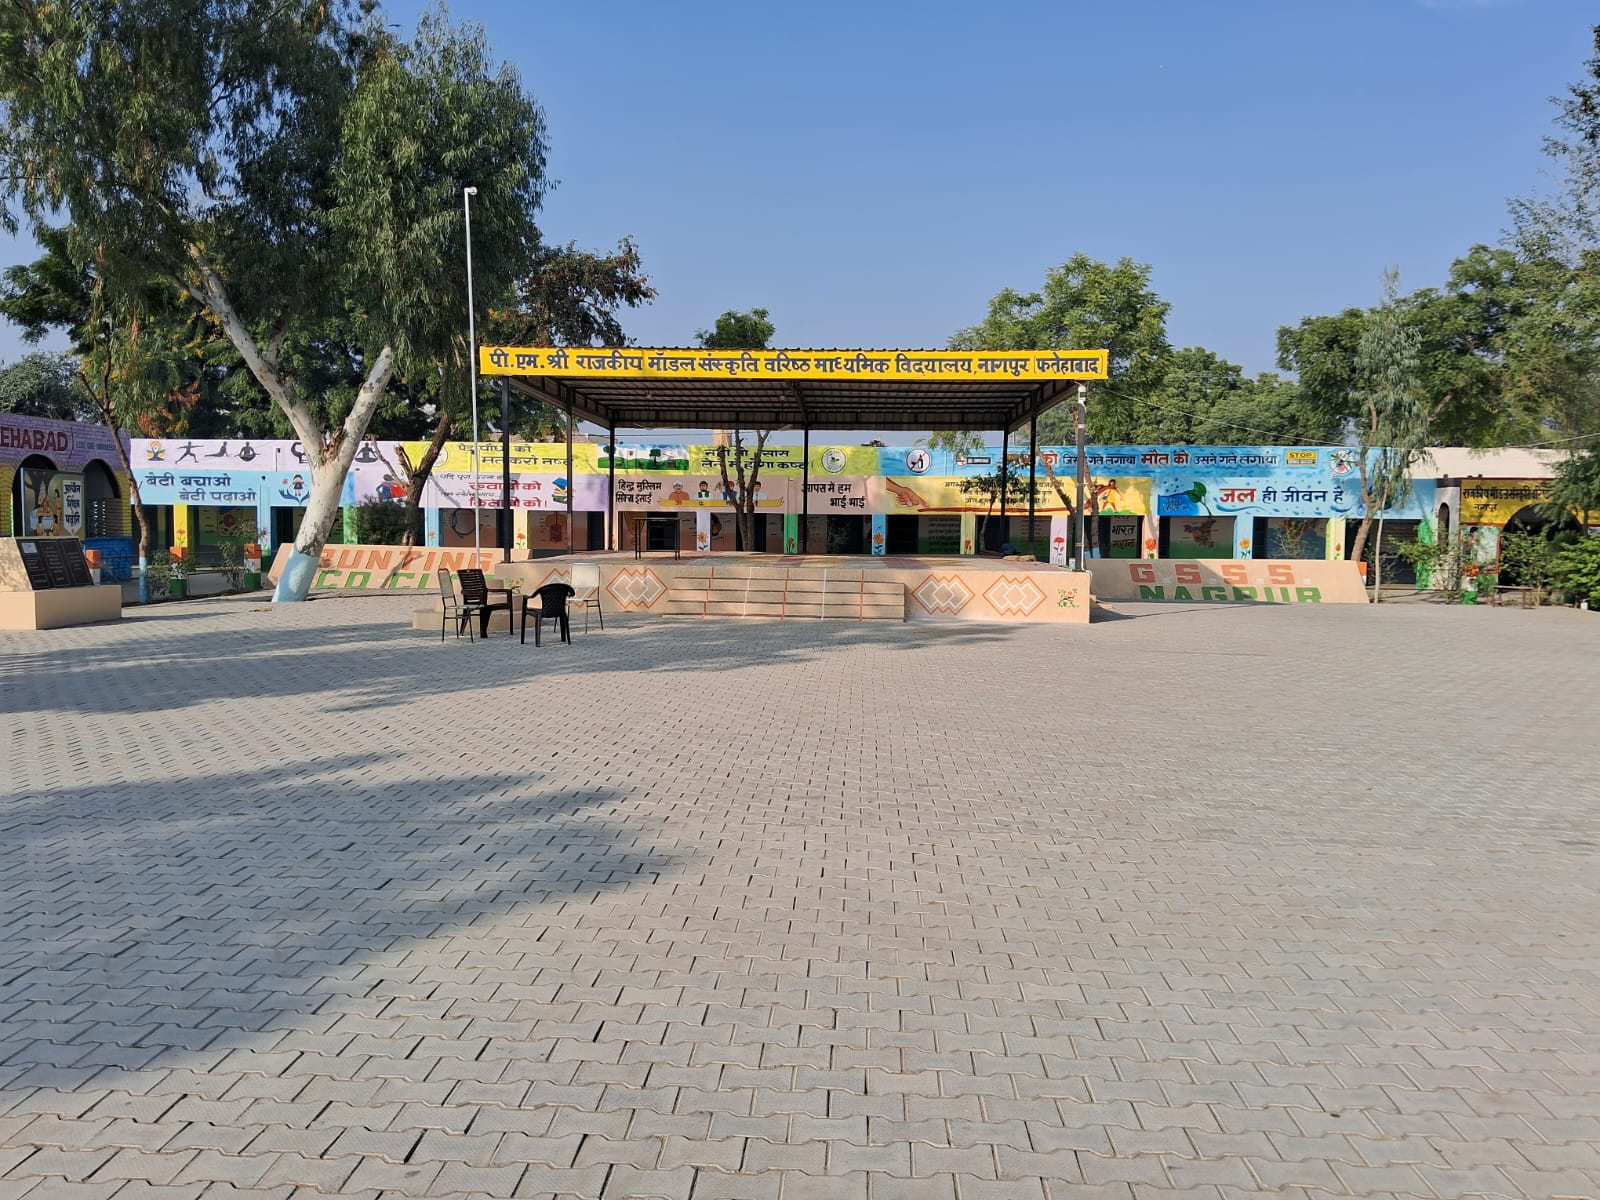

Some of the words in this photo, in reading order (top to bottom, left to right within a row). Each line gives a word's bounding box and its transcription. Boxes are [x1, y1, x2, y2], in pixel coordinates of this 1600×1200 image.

[576, 350, 643, 370] राजकीय
[648, 351, 696, 371] मॉडल
[699, 352, 760, 375] संस्कृति
[764, 352, 811, 372] वरिष्ठ
[814, 353, 891, 373] माध्यमिक
[978, 357, 1030, 376] नागपुर
[1141, 449, 1170, 465] मौत
[145, 472, 175, 486] बेटी
[180, 473, 231, 487] बचाओ
[180, 488, 205, 501] बेटी
[1219, 488, 1257, 503] जल
[1261, 486, 1278, 504] ही
[1281, 486, 1328, 503] जीवन
[1333, 486, 1344, 505] है
[1139, 585, 1323, 602] NAGPUR
